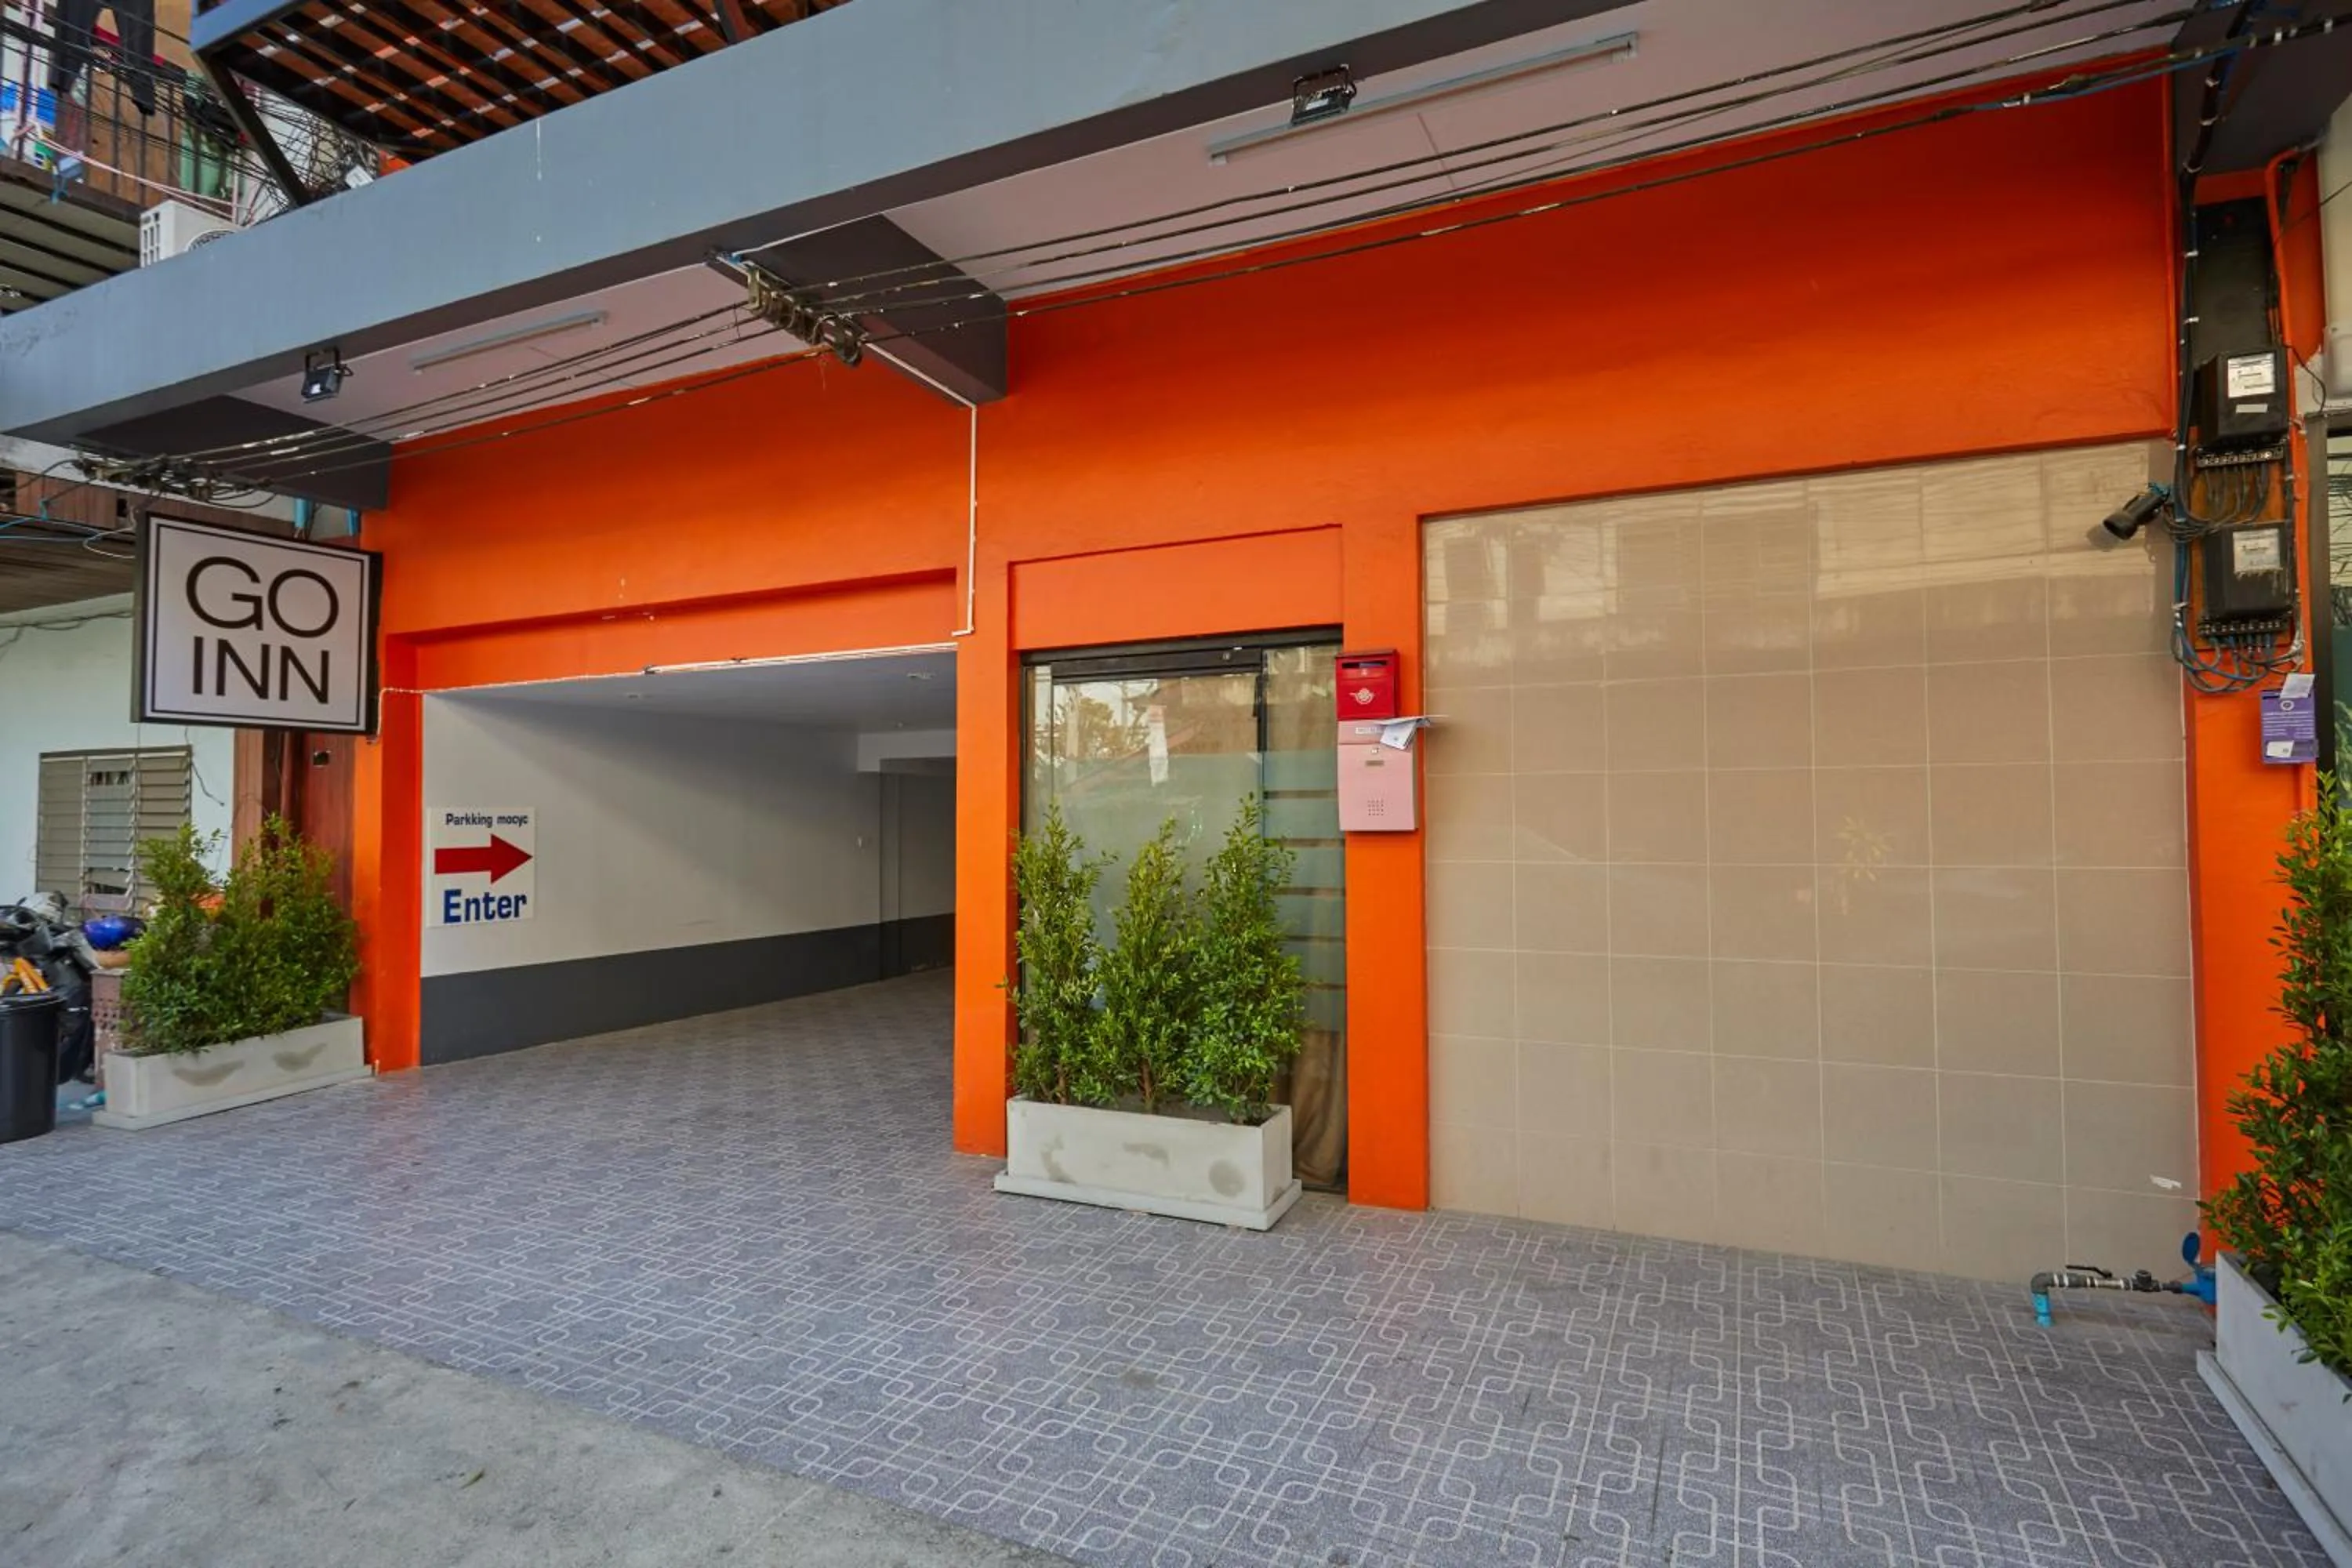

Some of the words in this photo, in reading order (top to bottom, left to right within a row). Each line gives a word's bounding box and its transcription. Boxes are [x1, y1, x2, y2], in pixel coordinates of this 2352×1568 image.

[186, 556, 339, 638] GO
[193, 636, 329, 704] INN
[445, 812, 493, 828] Parkking
[444, 888, 527, 924] Enter
